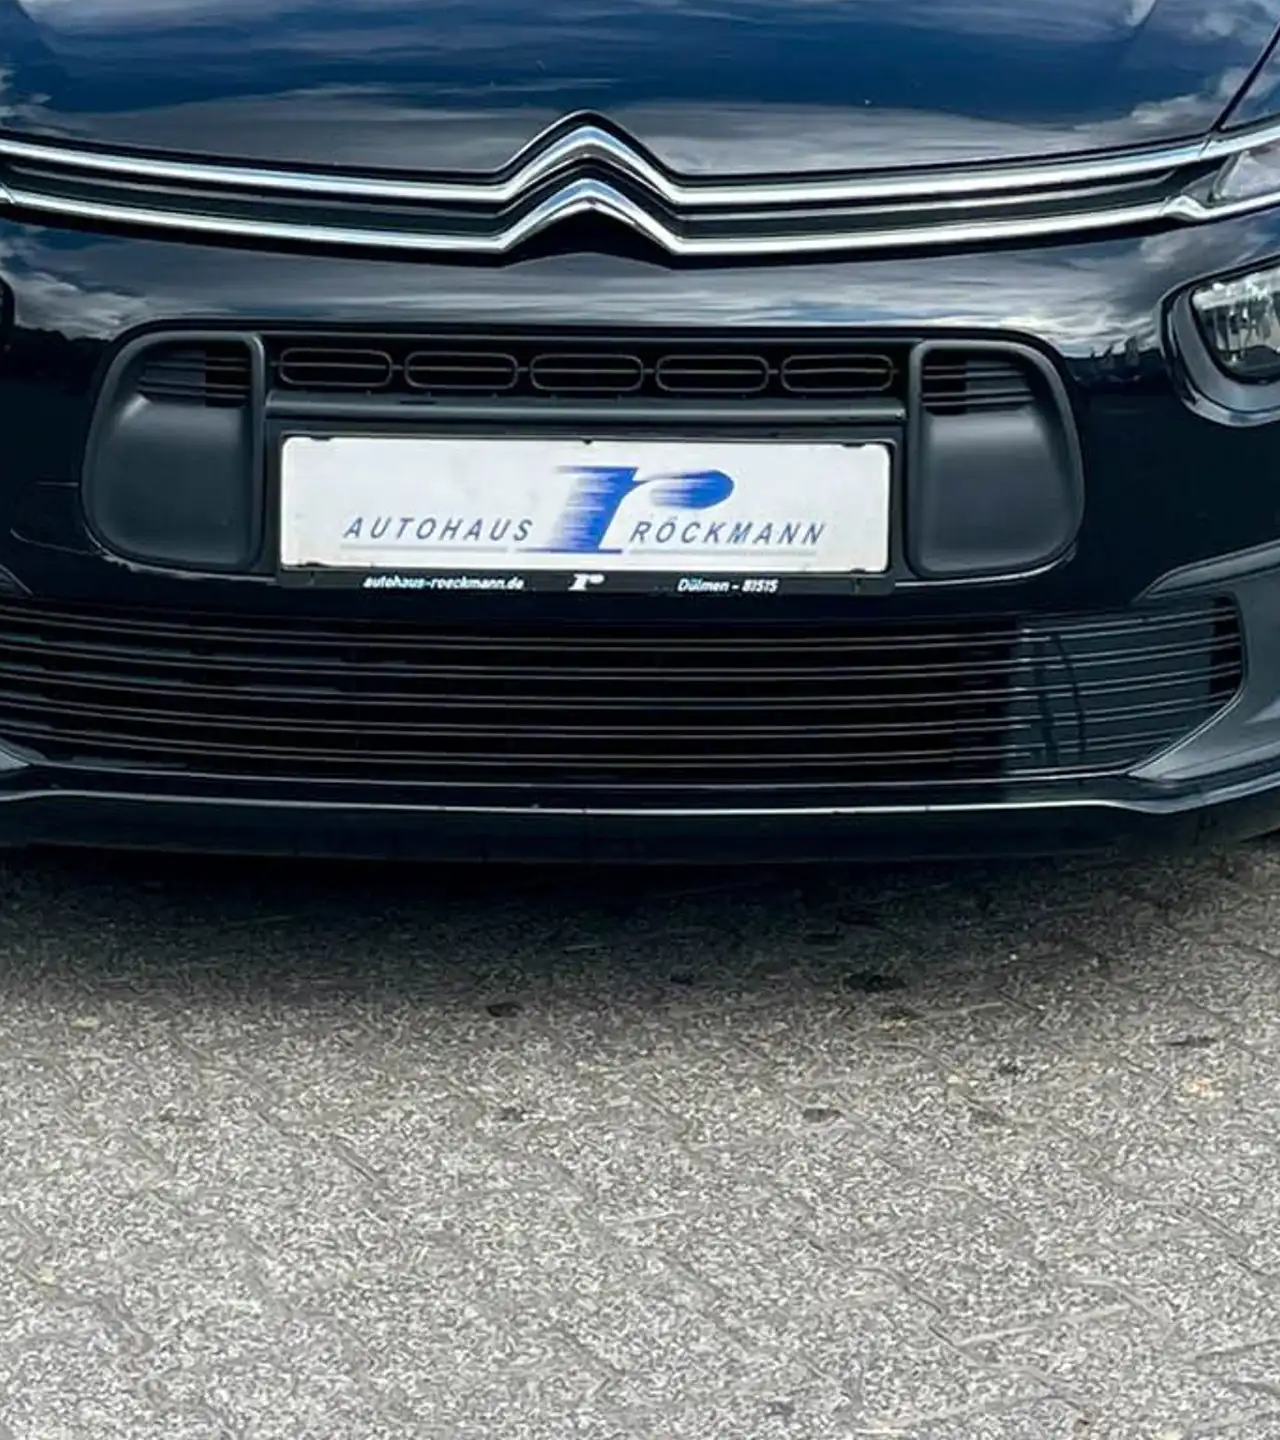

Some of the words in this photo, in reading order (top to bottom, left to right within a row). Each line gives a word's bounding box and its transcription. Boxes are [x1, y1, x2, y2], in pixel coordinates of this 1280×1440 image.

[342, 516, 534, 542] AUTOHAUS
[628, 515, 825, 545] RÖCKMANN
[362, 574, 525, 591] autohaus-roeckmann.de
[677, 576, 730, 593] Dülmen
